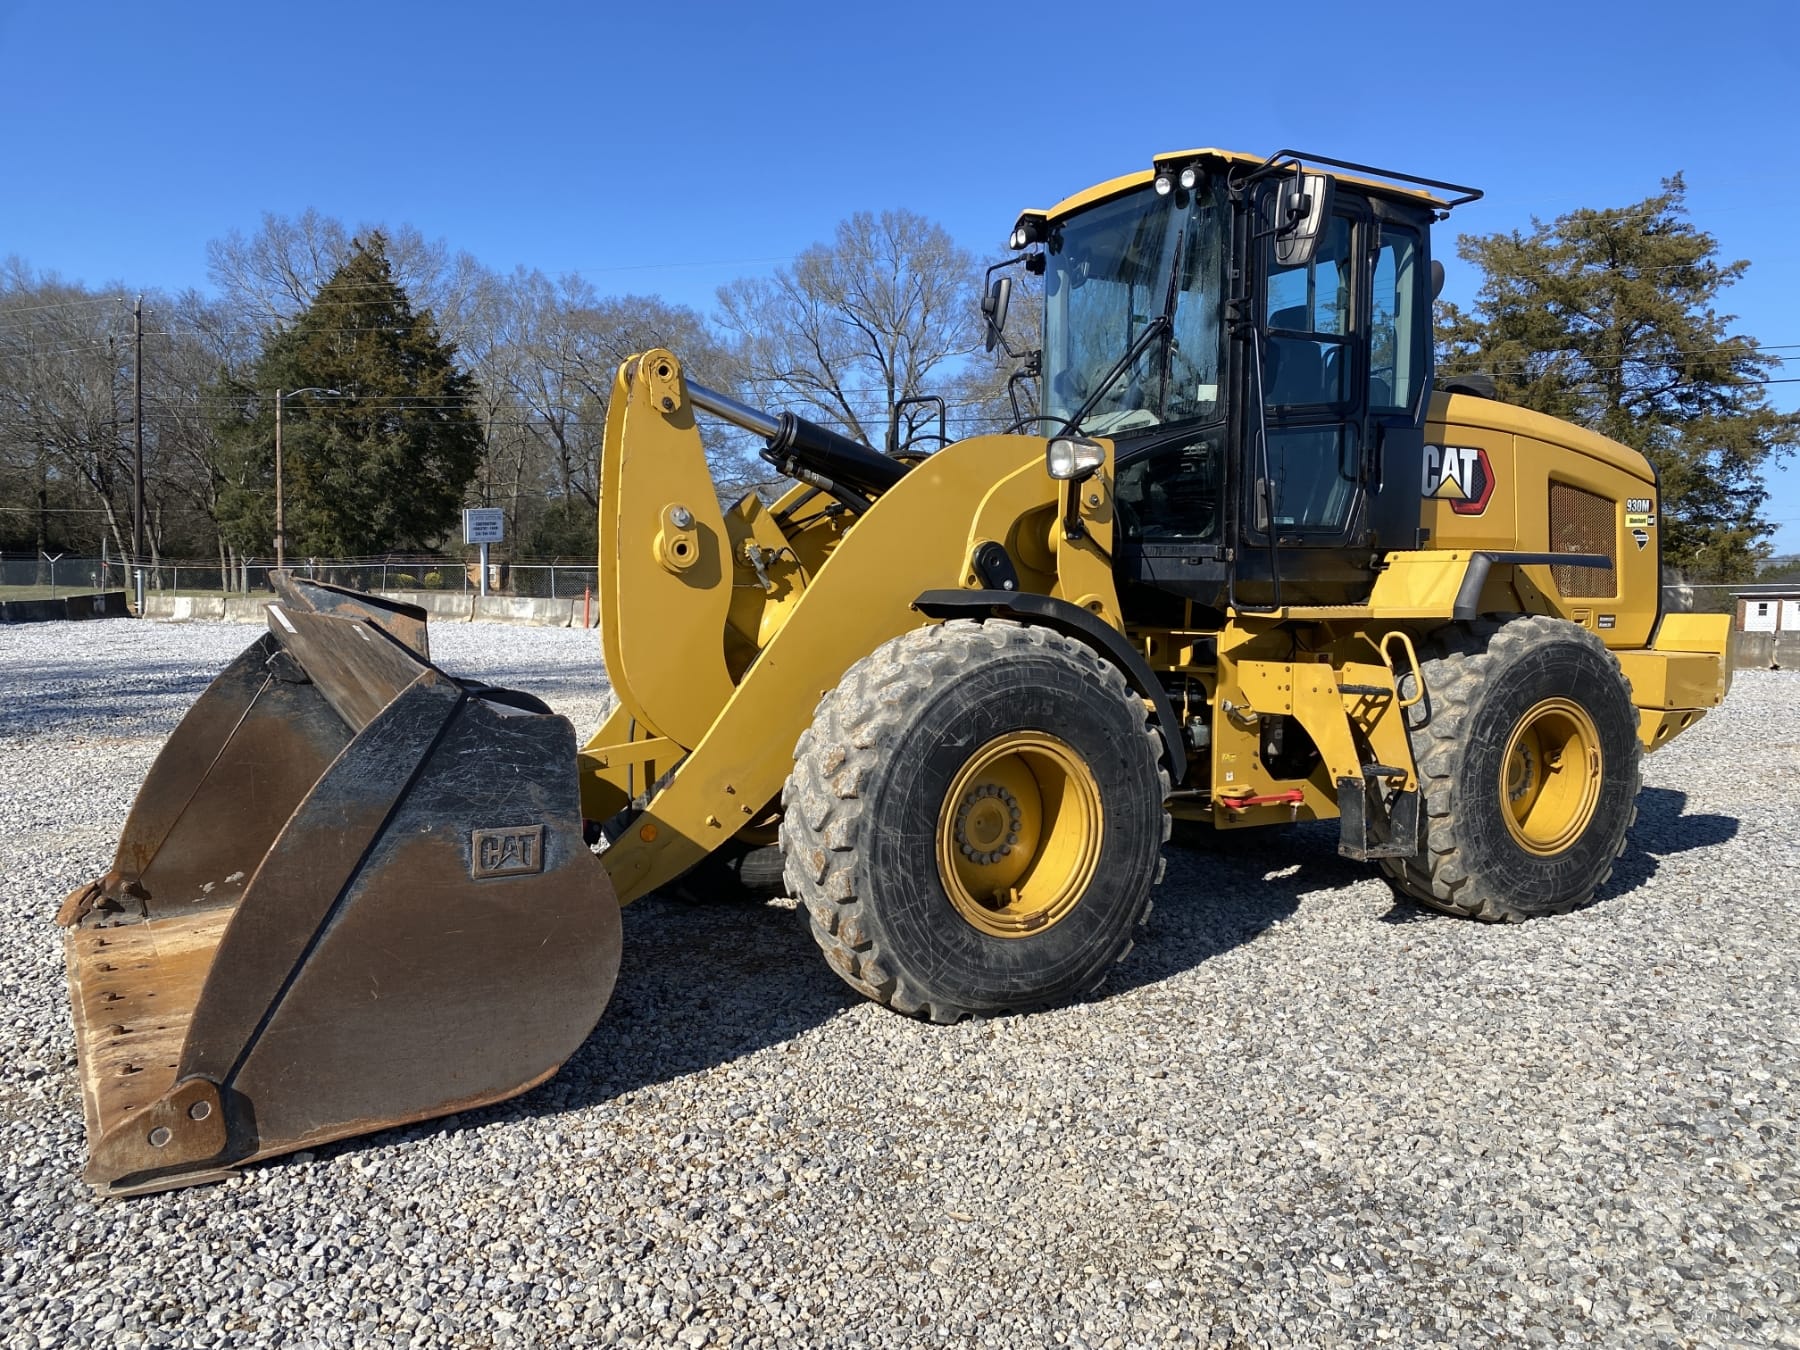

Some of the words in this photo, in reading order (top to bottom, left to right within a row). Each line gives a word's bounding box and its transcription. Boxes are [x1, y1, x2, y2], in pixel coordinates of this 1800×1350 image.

[1421, 445, 1478, 499] CAT
[1627, 499, 1650, 512] 930M
[481, 834, 536, 869] CAT
